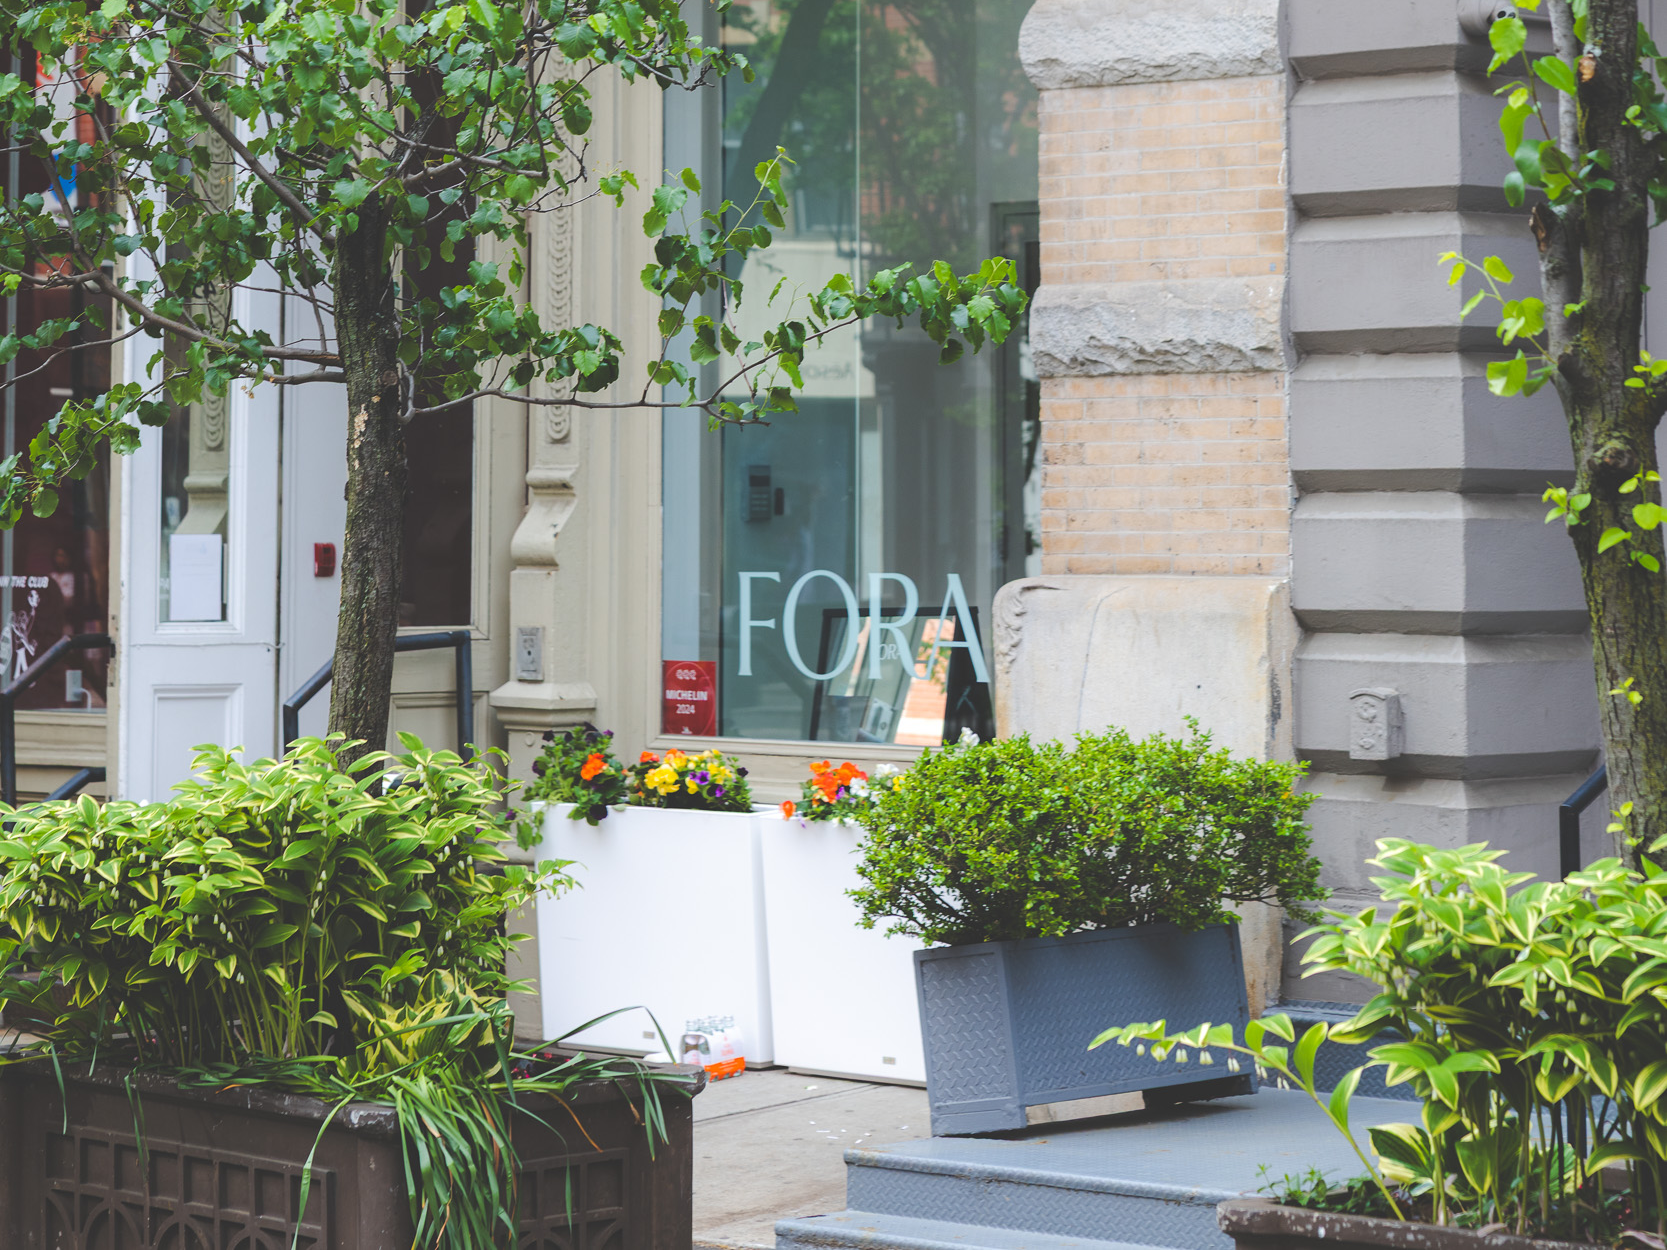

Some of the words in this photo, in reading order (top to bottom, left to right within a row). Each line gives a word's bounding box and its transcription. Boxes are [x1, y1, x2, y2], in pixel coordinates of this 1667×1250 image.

[11, 576, 27, 588] THE
[27, 576, 49, 588] CLUB
[738, 569, 990, 683] FORA
[665, 689, 708, 701] MICHELIN
[676, 703, 696, 714] 2024
